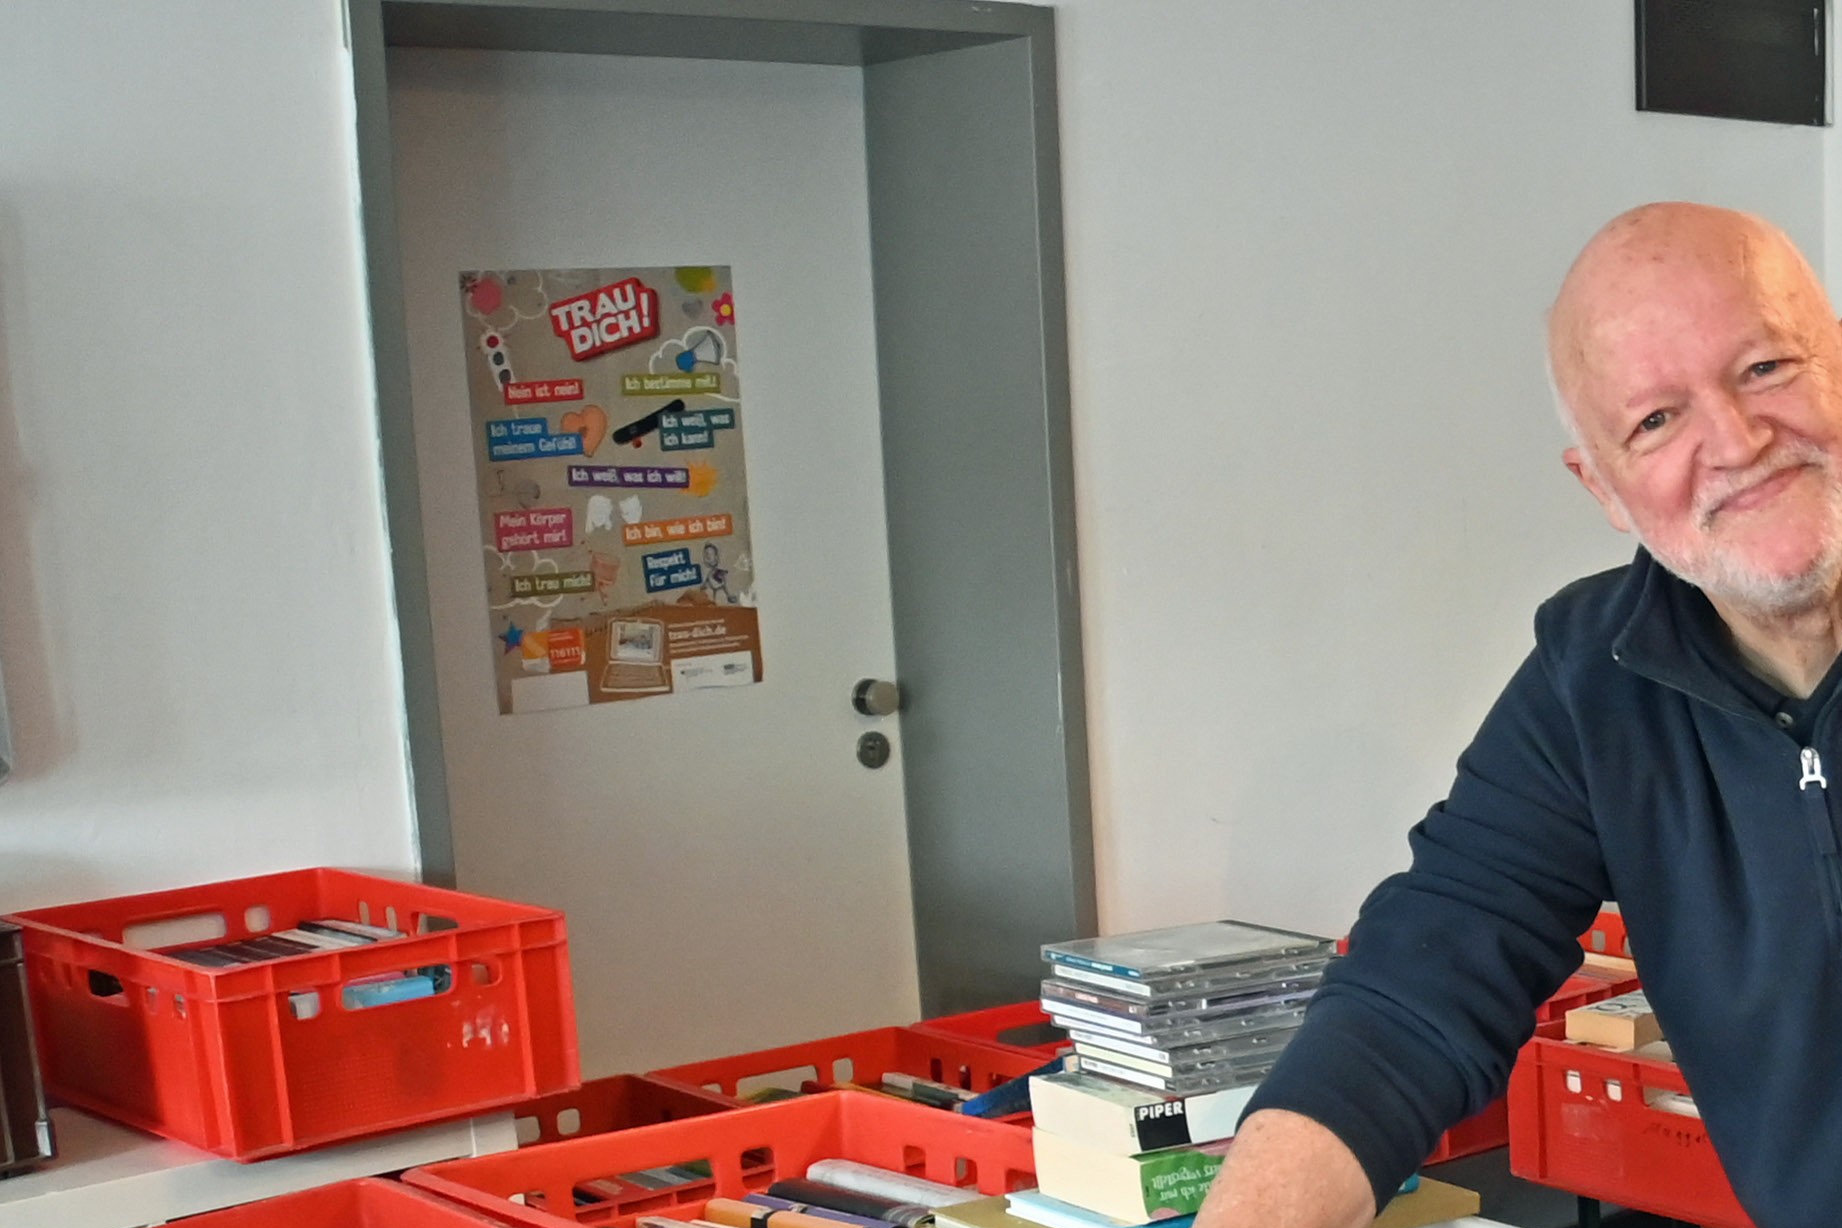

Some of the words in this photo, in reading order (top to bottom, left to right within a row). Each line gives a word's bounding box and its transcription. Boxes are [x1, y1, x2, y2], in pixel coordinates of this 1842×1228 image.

[551, 284, 637, 332] TRAU
[570, 292, 651, 355] DICH!
[625, 377, 640, 389] Ich
[508, 385, 531, 399] Nein
[662, 415, 678, 429] Ich
[491, 423, 508, 437] Ich
[663, 432, 678, 445] ich
[572, 468, 588, 482] Ich
[623, 472, 643, 483] was
[647, 469, 662, 483] ich
[500, 512, 526, 528] Mein
[625, 526, 642, 540] Ich
[688, 520, 704, 534] ich
[514, 578, 531, 592] Ich
[1138, 1100, 1184, 1121] PIPER
